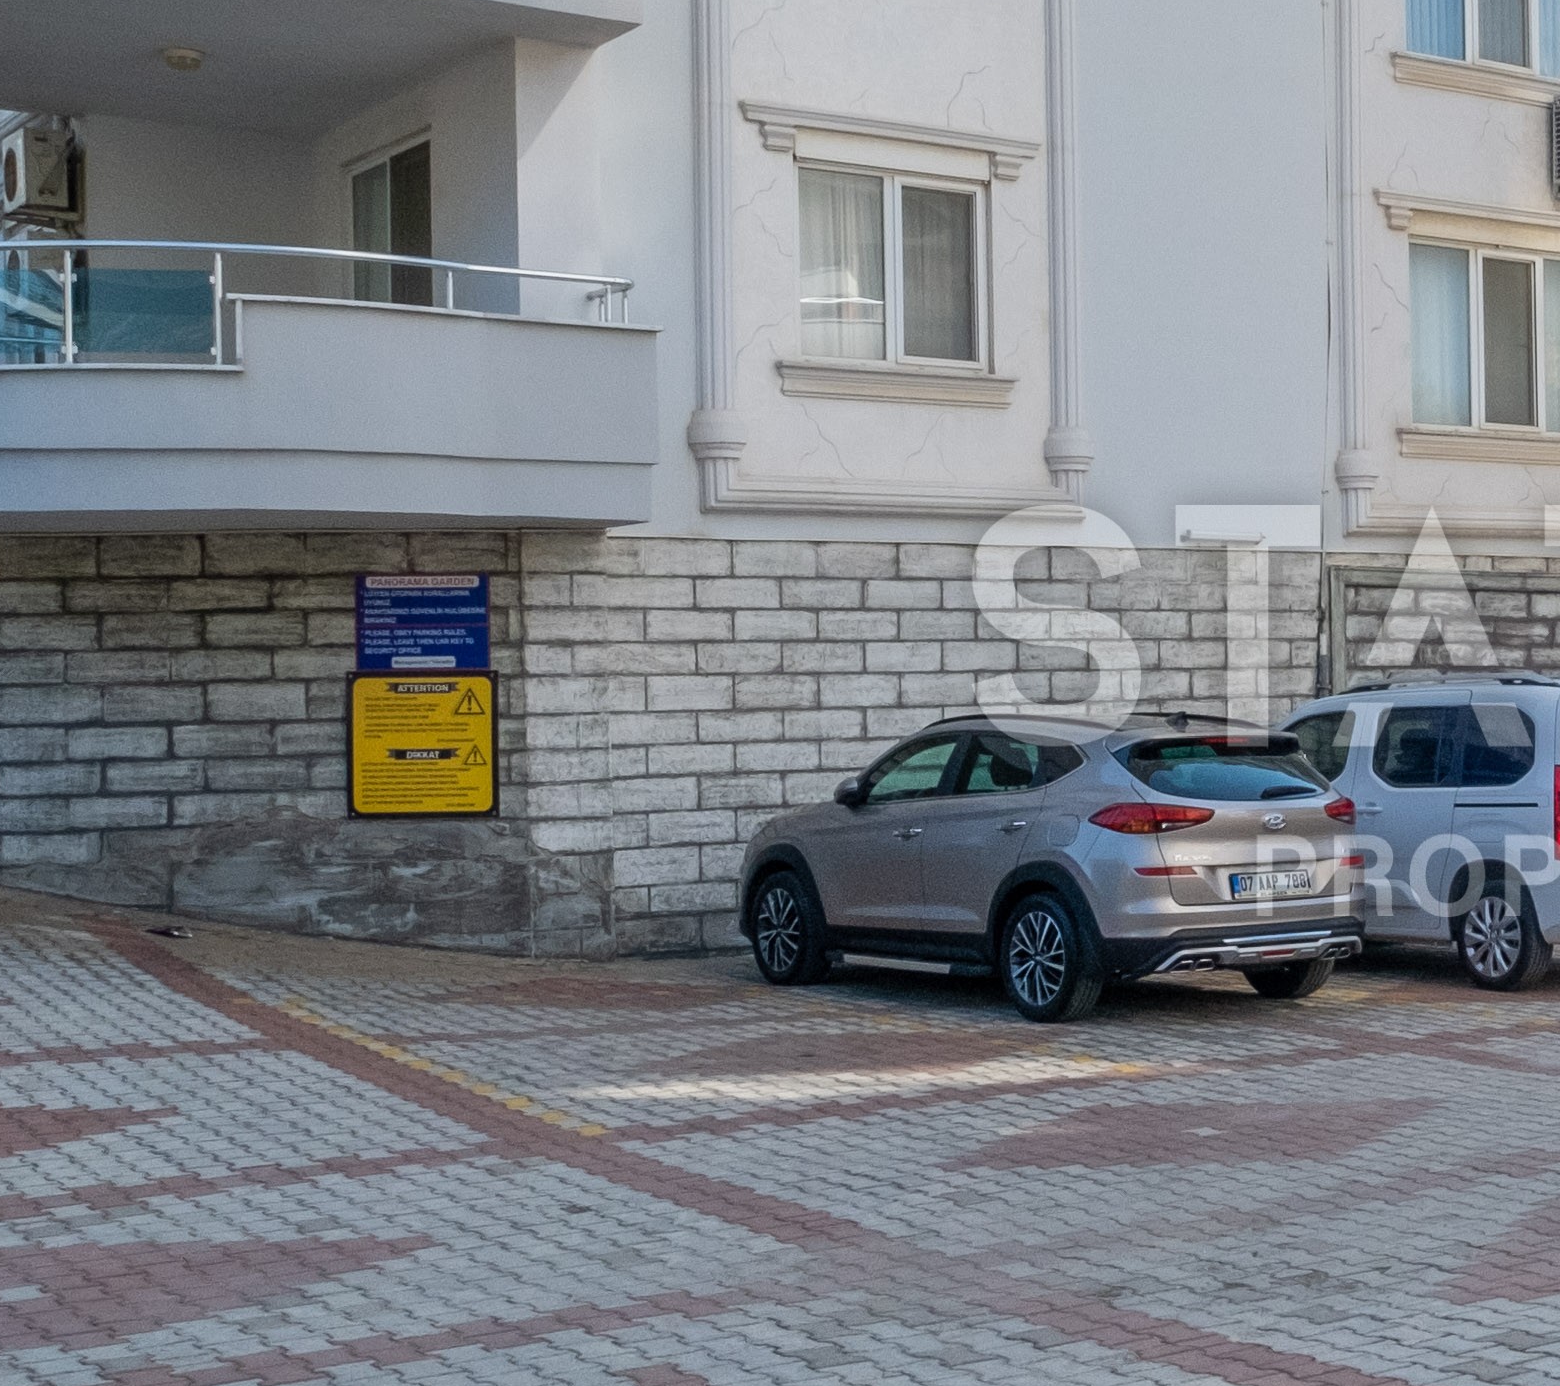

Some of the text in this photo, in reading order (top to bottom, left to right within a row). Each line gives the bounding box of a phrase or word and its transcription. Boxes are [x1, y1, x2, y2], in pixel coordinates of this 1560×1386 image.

[370, 577, 474, 587] PANORAMA GARDEN
[397, 684, 449, 693] ATTENTION
[1240, 876, 1253, 892] 07
[1259, 874, 1279, 891] AAP
